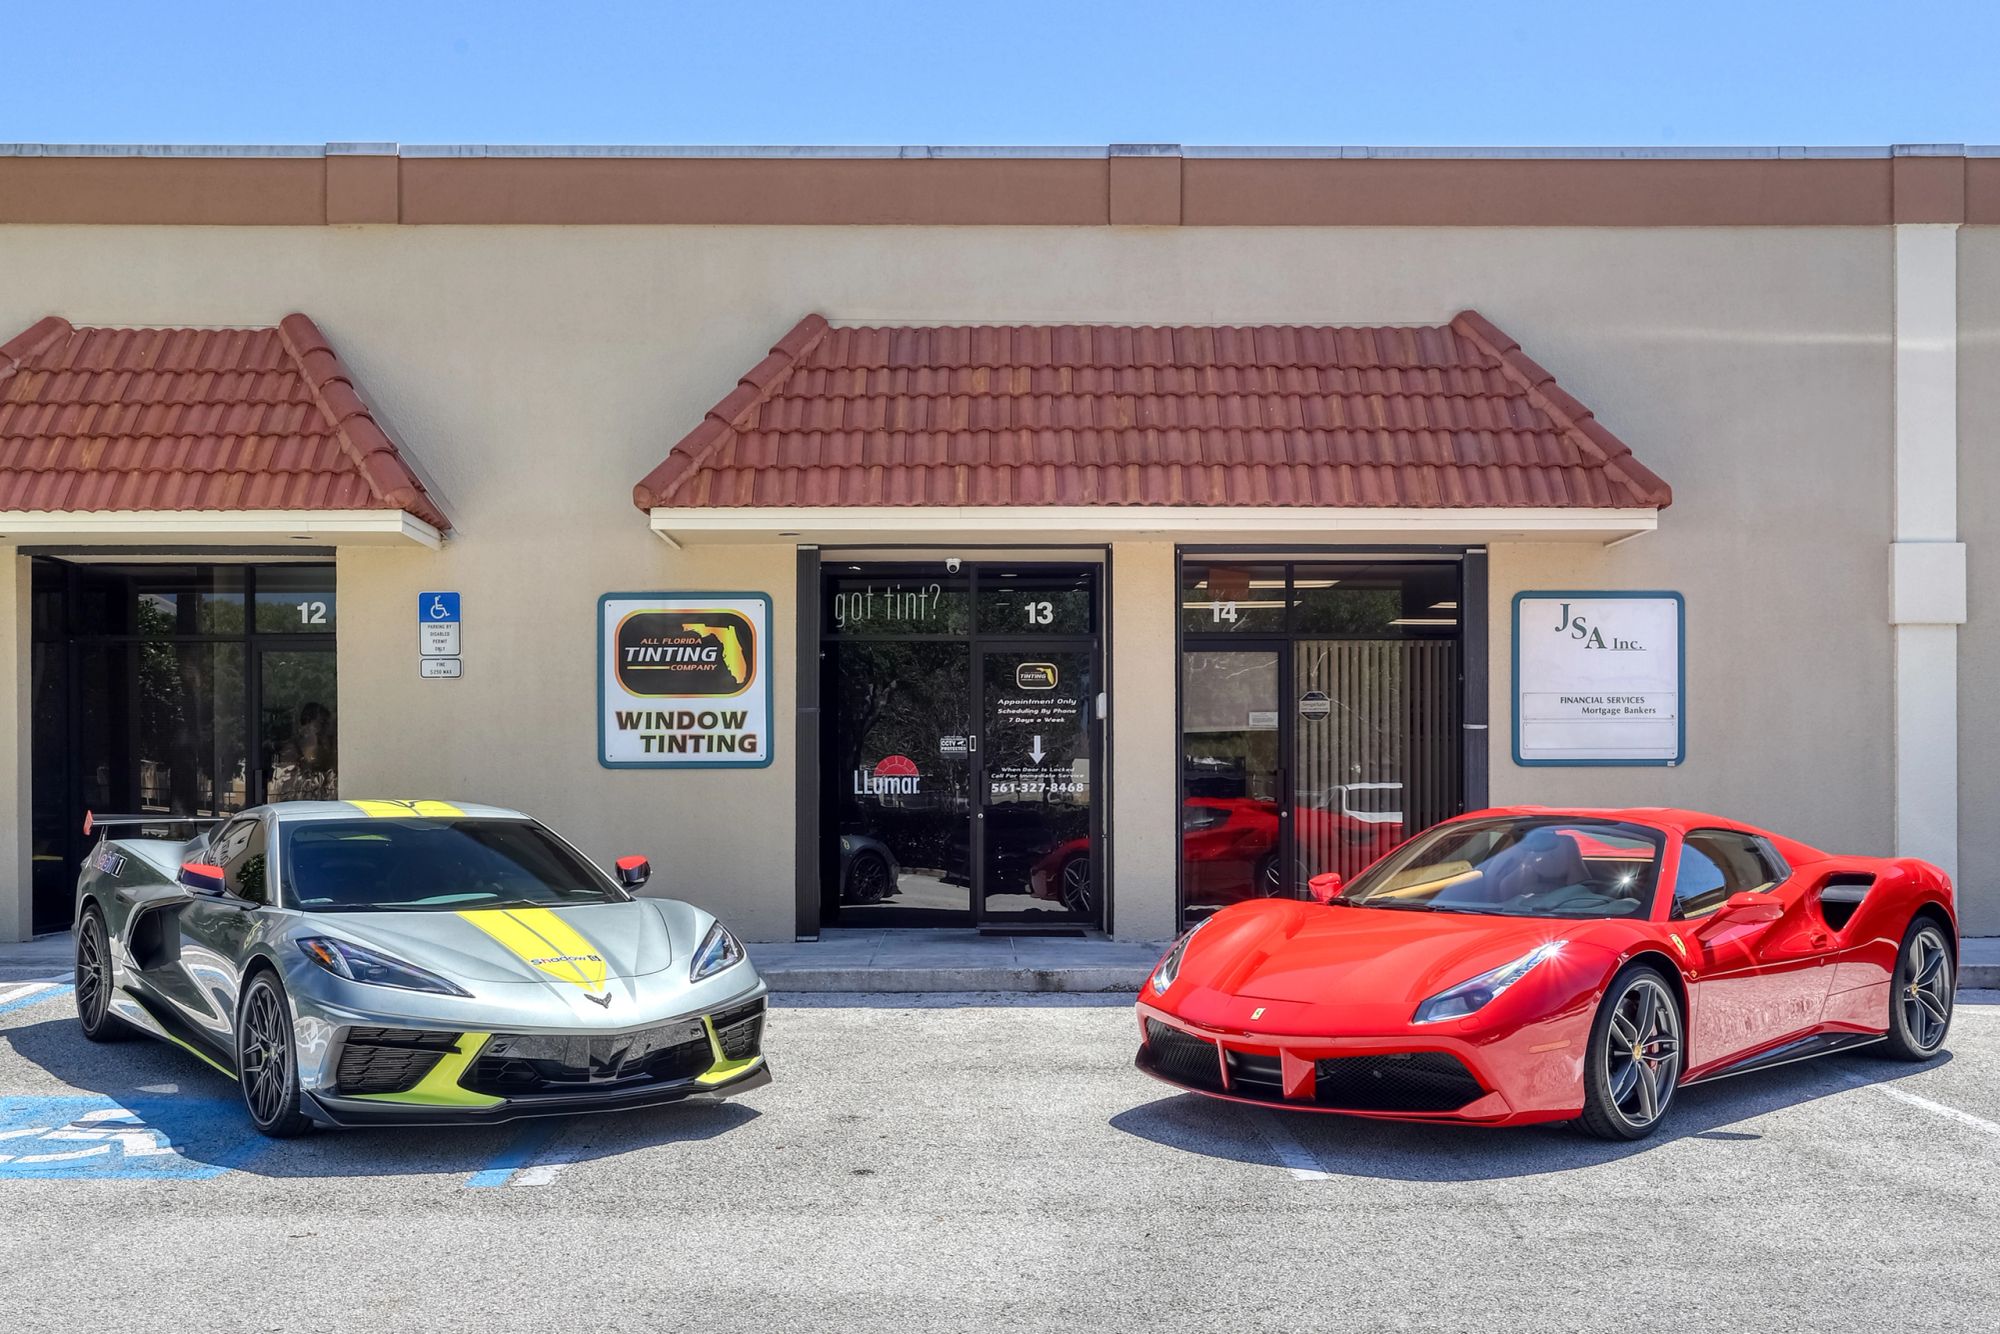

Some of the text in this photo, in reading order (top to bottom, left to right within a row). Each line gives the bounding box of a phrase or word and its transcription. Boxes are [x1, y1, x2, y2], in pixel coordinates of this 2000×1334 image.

[297, 601, 327, 624] 12
[835, 583, 940, 627] got tint?
[1024, 601, 1054, 624] 13
[1209, 600, 1238, 623] 14
[640, 637, 702, 645] ALL FLORIDA
[1613, 637, 1643, 650] Inc.
[625, 647, 718, 662] TINTING
[997, 698, 1077, 706] Appointment Only
[1560, 696, 1645, 704] FINANCIAL SERVICES
[1582, 706, 1656, 716] Mortgage Bankers
[615, 711, 748, 730] WINDOW
[640, 734, 757, 753] TINTING
[991, 783, 1084, 793] 561-327-8468
